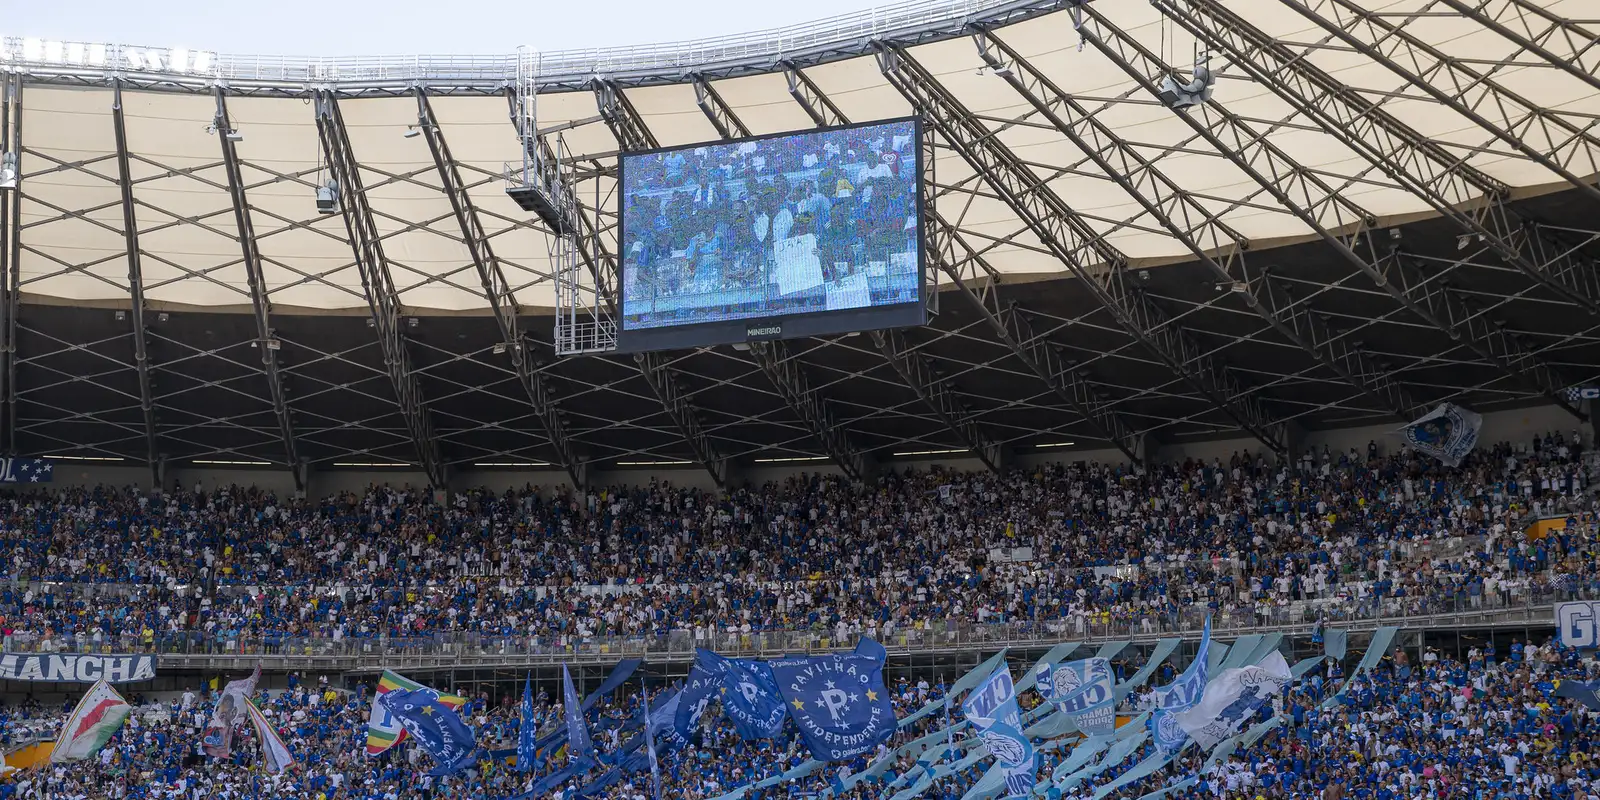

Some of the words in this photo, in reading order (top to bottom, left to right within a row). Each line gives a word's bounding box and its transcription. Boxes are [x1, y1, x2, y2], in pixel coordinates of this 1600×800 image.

[1559, 602, 1600, 648] G
[790, 662, 869, 692] PAVILHÃO
[800, 706, 884, 746] INDEPENDENTE
